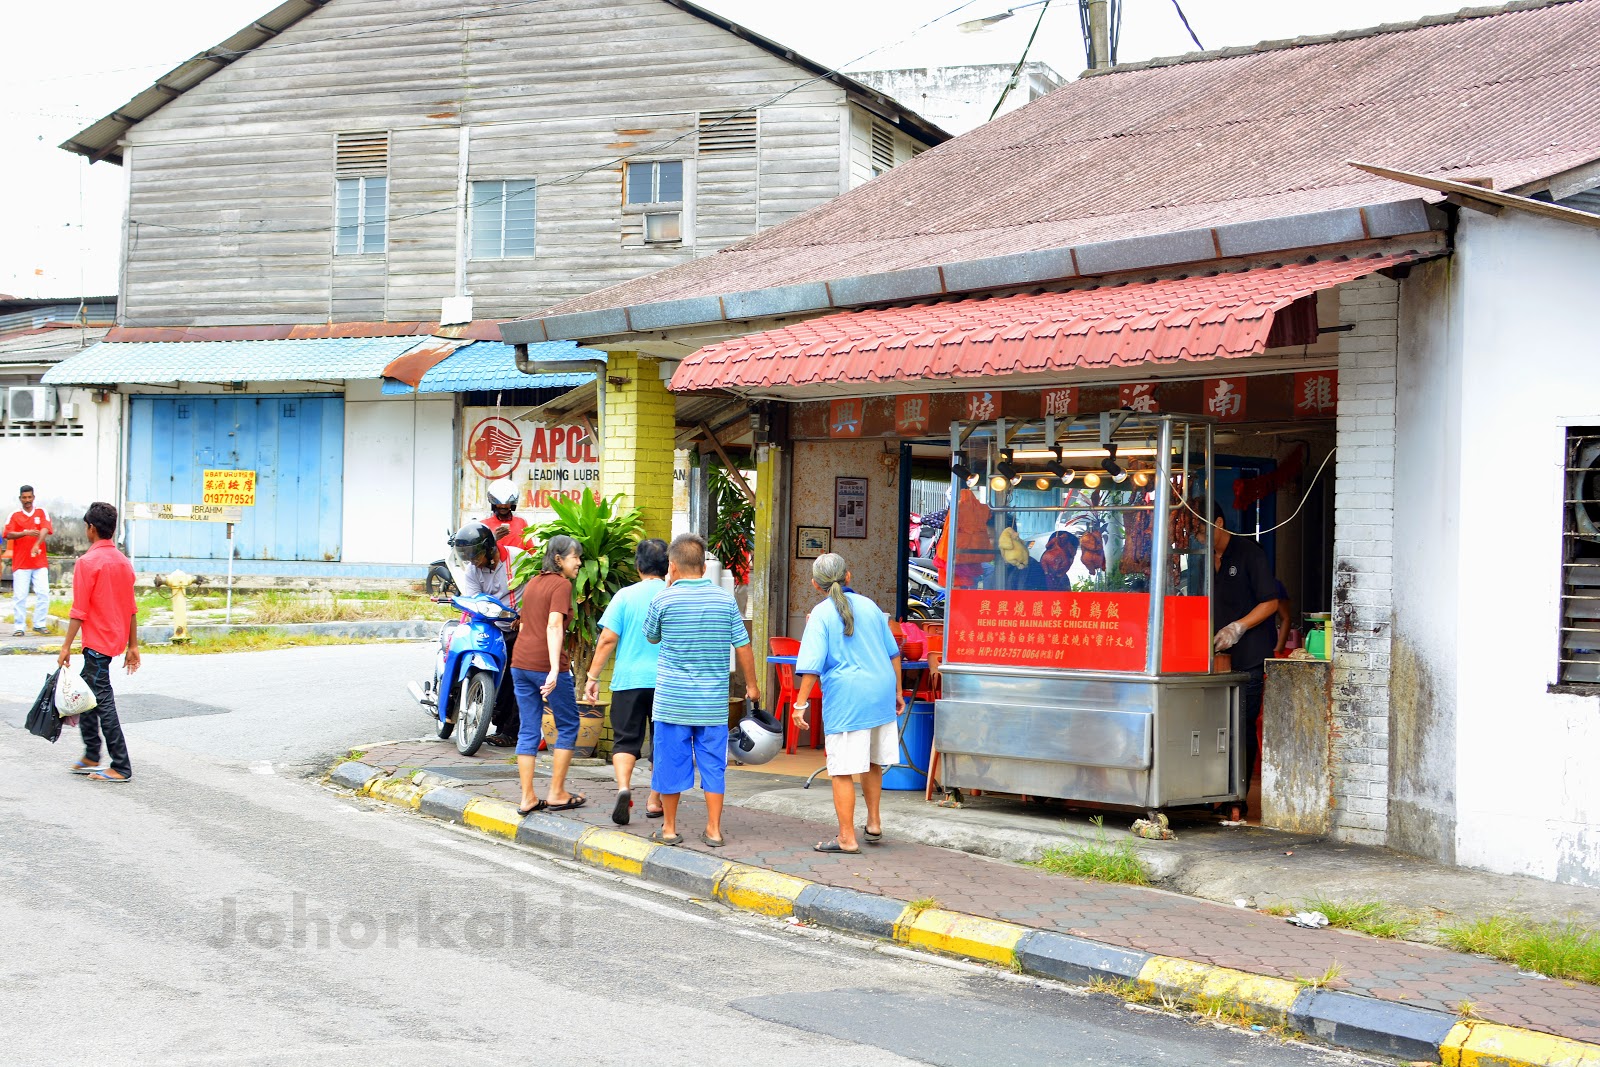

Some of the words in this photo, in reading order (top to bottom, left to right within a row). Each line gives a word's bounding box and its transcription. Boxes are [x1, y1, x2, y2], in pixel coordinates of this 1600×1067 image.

[529, 425, 599, 464] APOL
[528, 469, 569, 481] LEADING
[203, 493, 254, 505] 0197779521
[192, 505, 223, 514] IBRAHIM
[977, 618, 997, 627] HENG
[998, 619, 1018, 628] HENG
[1019, 619, 1062, 628] HAINANESE
[1063, 620, 1099, 629] CHICKEN
[1100, 621, 1119, 630] RICE
[978, 646, 993, 657] H/P:
[993, 647, 1022, 658] 012-757
[1021, 648, 1040, 660] 0064
